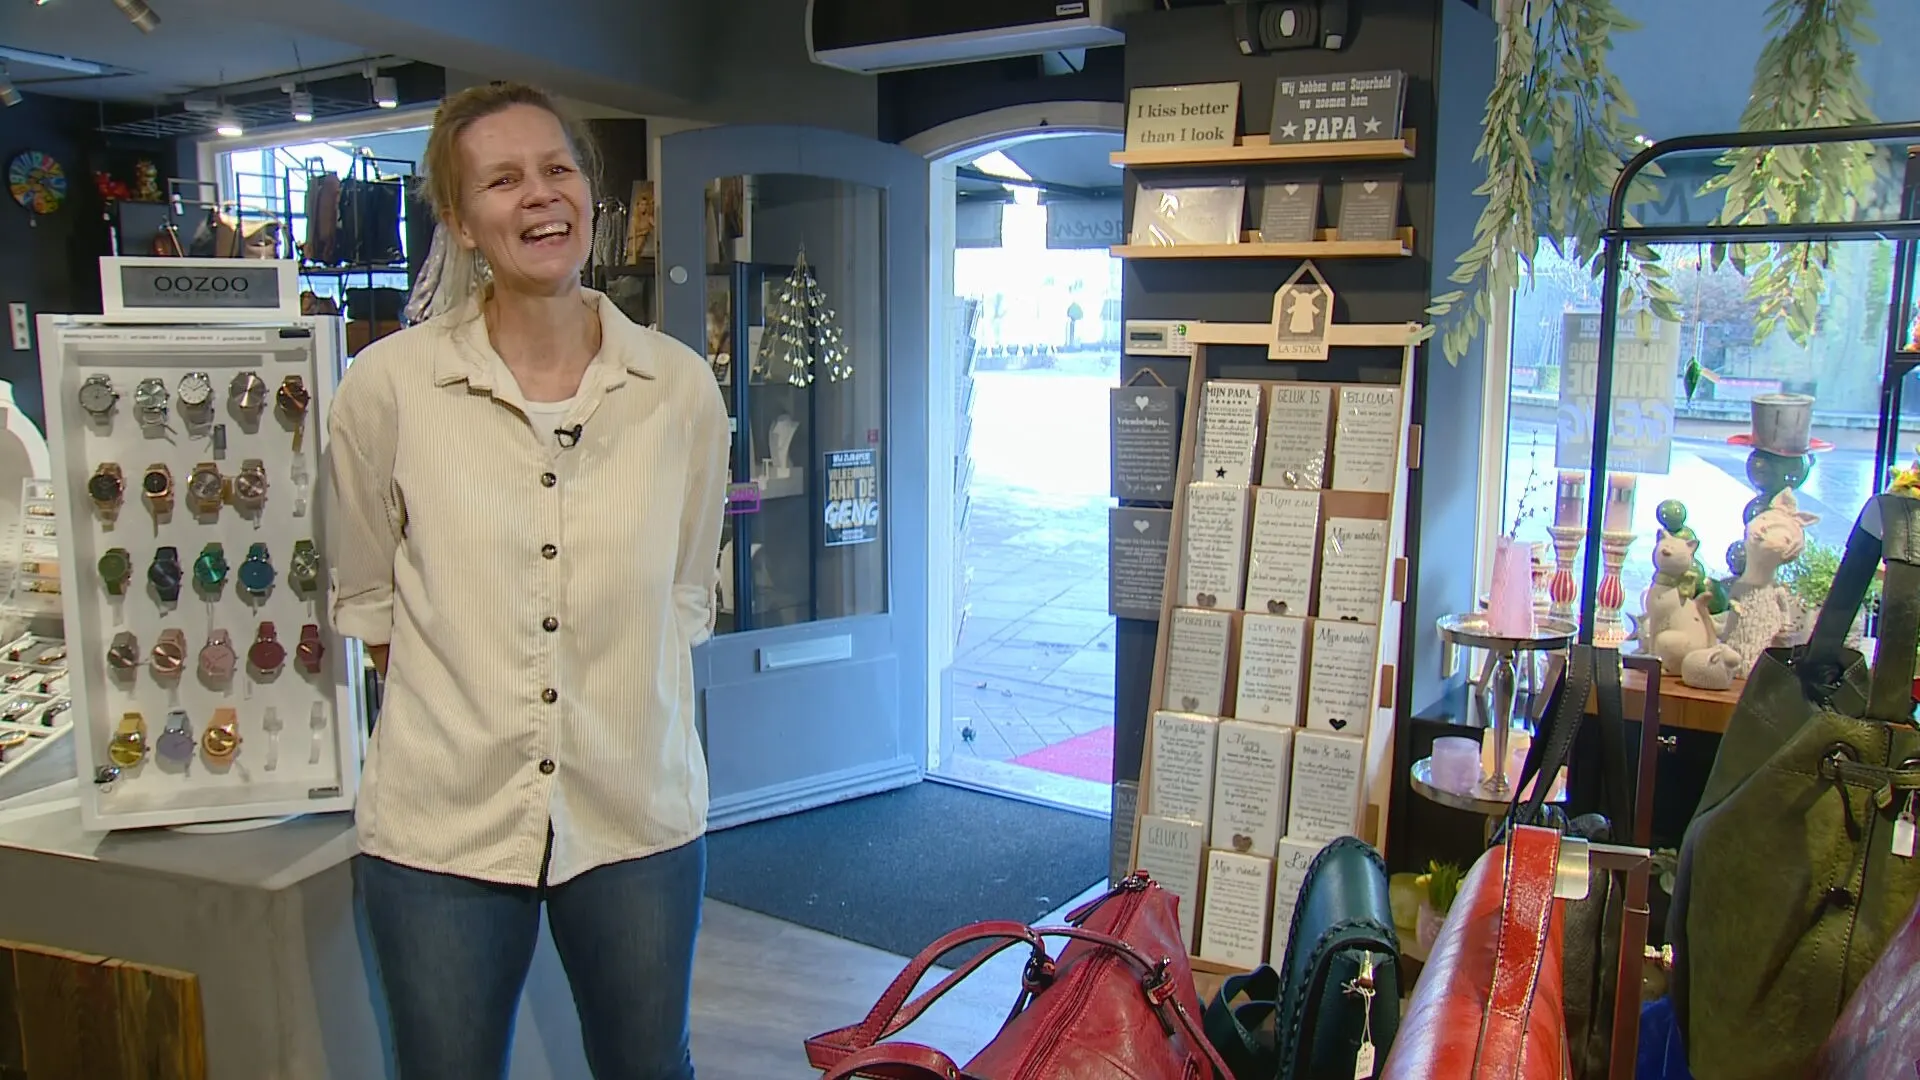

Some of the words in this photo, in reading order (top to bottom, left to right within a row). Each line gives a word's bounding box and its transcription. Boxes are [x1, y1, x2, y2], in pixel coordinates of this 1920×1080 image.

[1281, 81, 1295, 97] Wij
[1299, 80, 1327, 94] hebben
[1331, 81, 1346, 92] een
[1350, 75, 1392, 93] Superheld
[1137, 104, 1143, 118] I
[1147, 103, 1177, 118] kiss
[1181, 102, 1230, 116] better
[1299, 98, 1311, 109] we
[1315, 97, 1346, 109] noemen
[1350, 94, 1368, 107] hem
[1140, 130, 1175, 143] than
[1180, 127, 1187, 141] I
[1191, 126, 1225, 141] look
[1303, 116, 1357, 141] PAPA
[154, 276, 248, 292] OOZOO
[1277, 388, 1306, 404] GELUK
[1309, 389, 1321, 404] IS
[829, 479, 855, 500] AAN
[859, 478, 875, 498] DE
[825, 499, 879, 529] GENG
[1148, 827, 1178, 848] GELUK
[1179, 831, 1189, 850] IS
